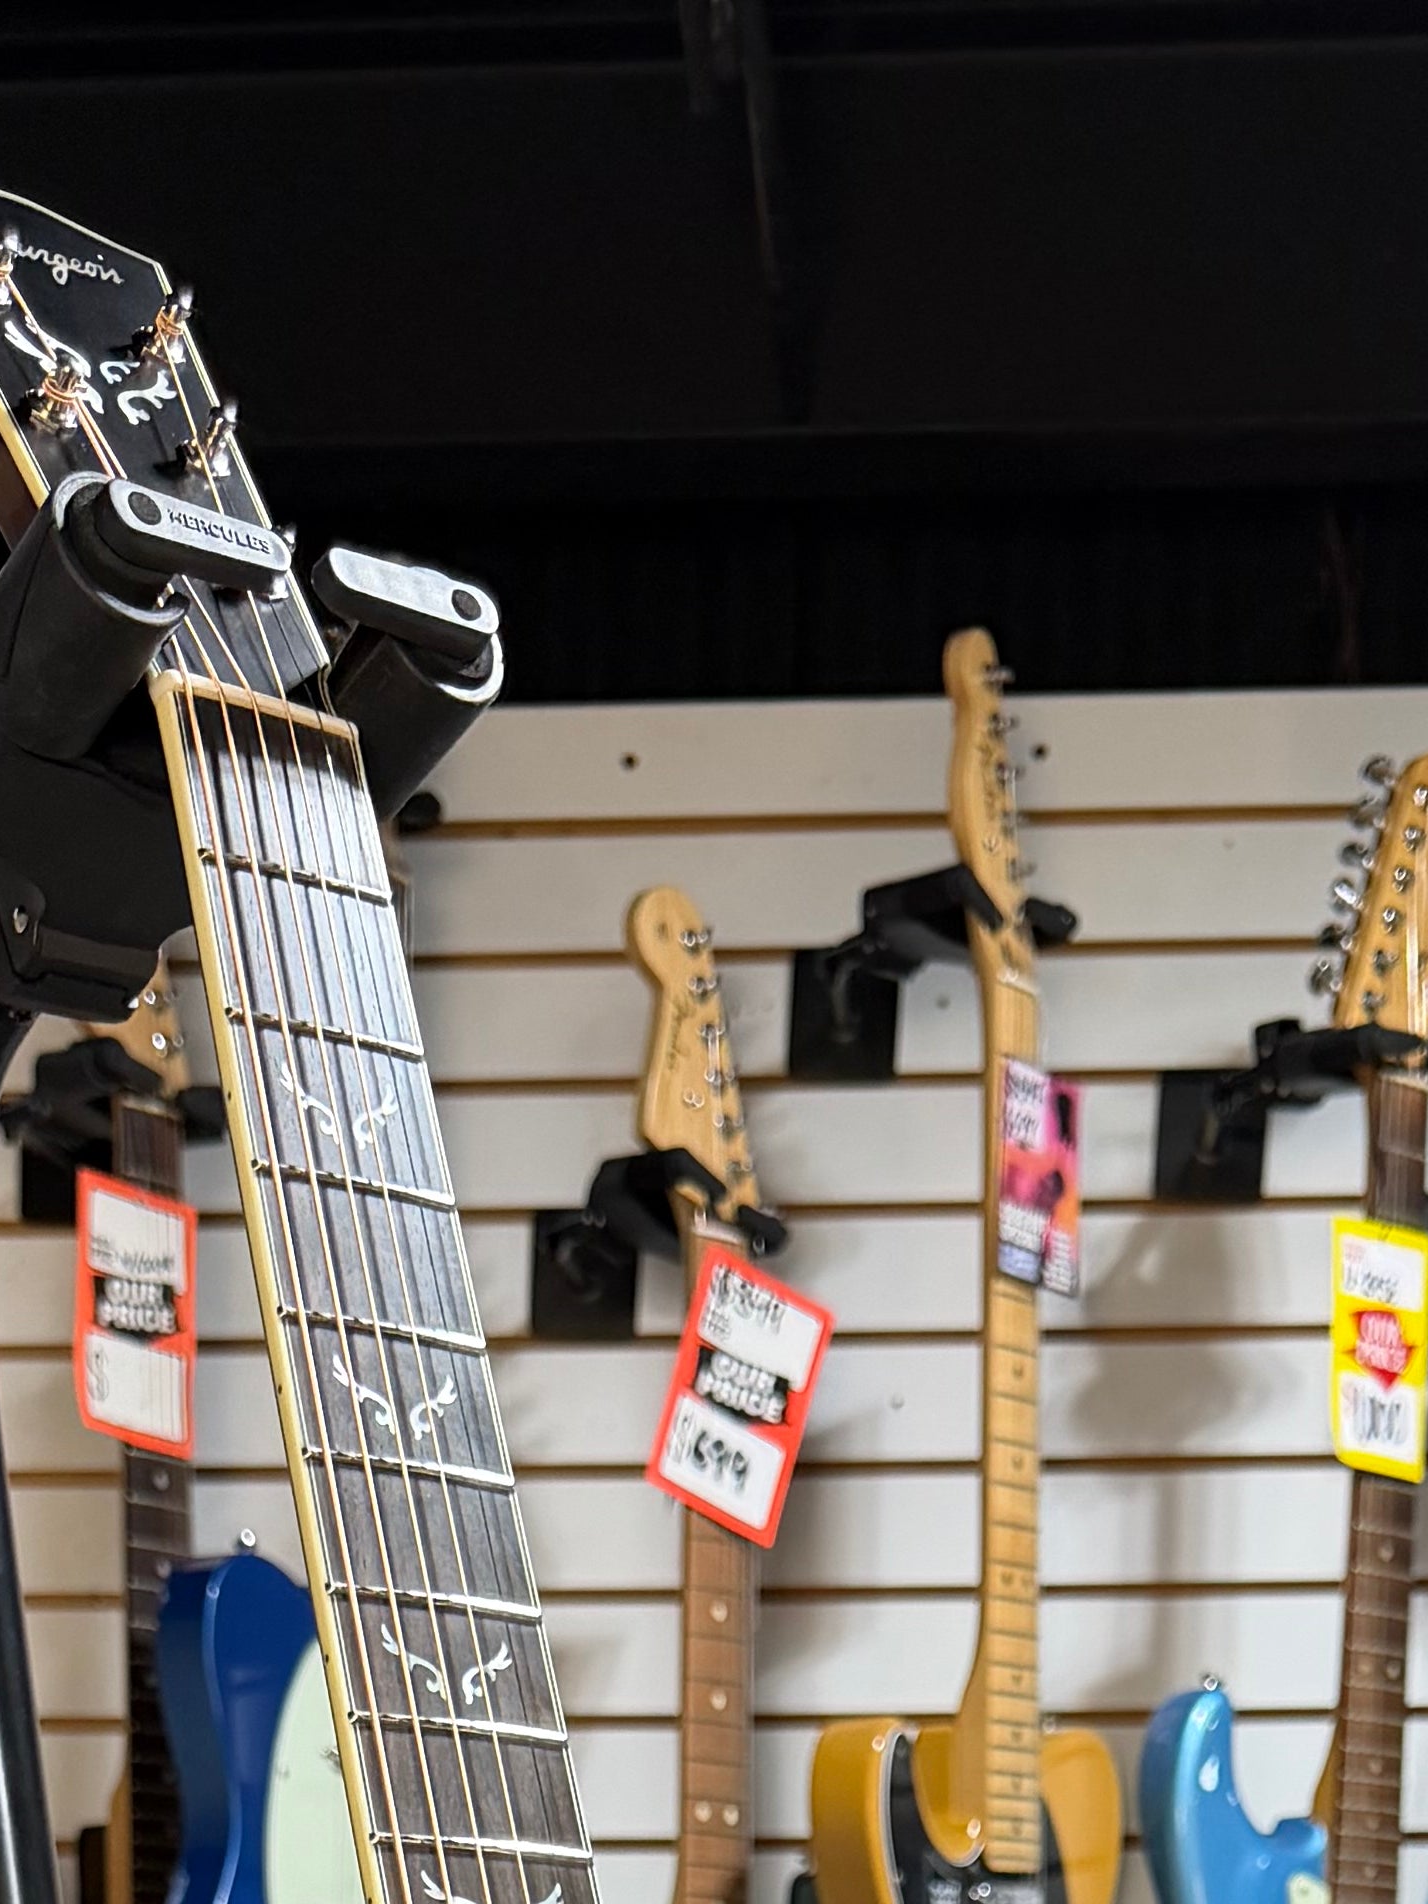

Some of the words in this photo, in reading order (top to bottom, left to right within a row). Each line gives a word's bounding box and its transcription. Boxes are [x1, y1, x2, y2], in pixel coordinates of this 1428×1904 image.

[166, 506, 272, 555] HERCULES
[103, 1276, 165, 1304] OUR
[95, 1301, 177, 1334] PRICE
[710, 1349, 777, 1394] OUR
[694, 1372, 787, 1425] PRICE
